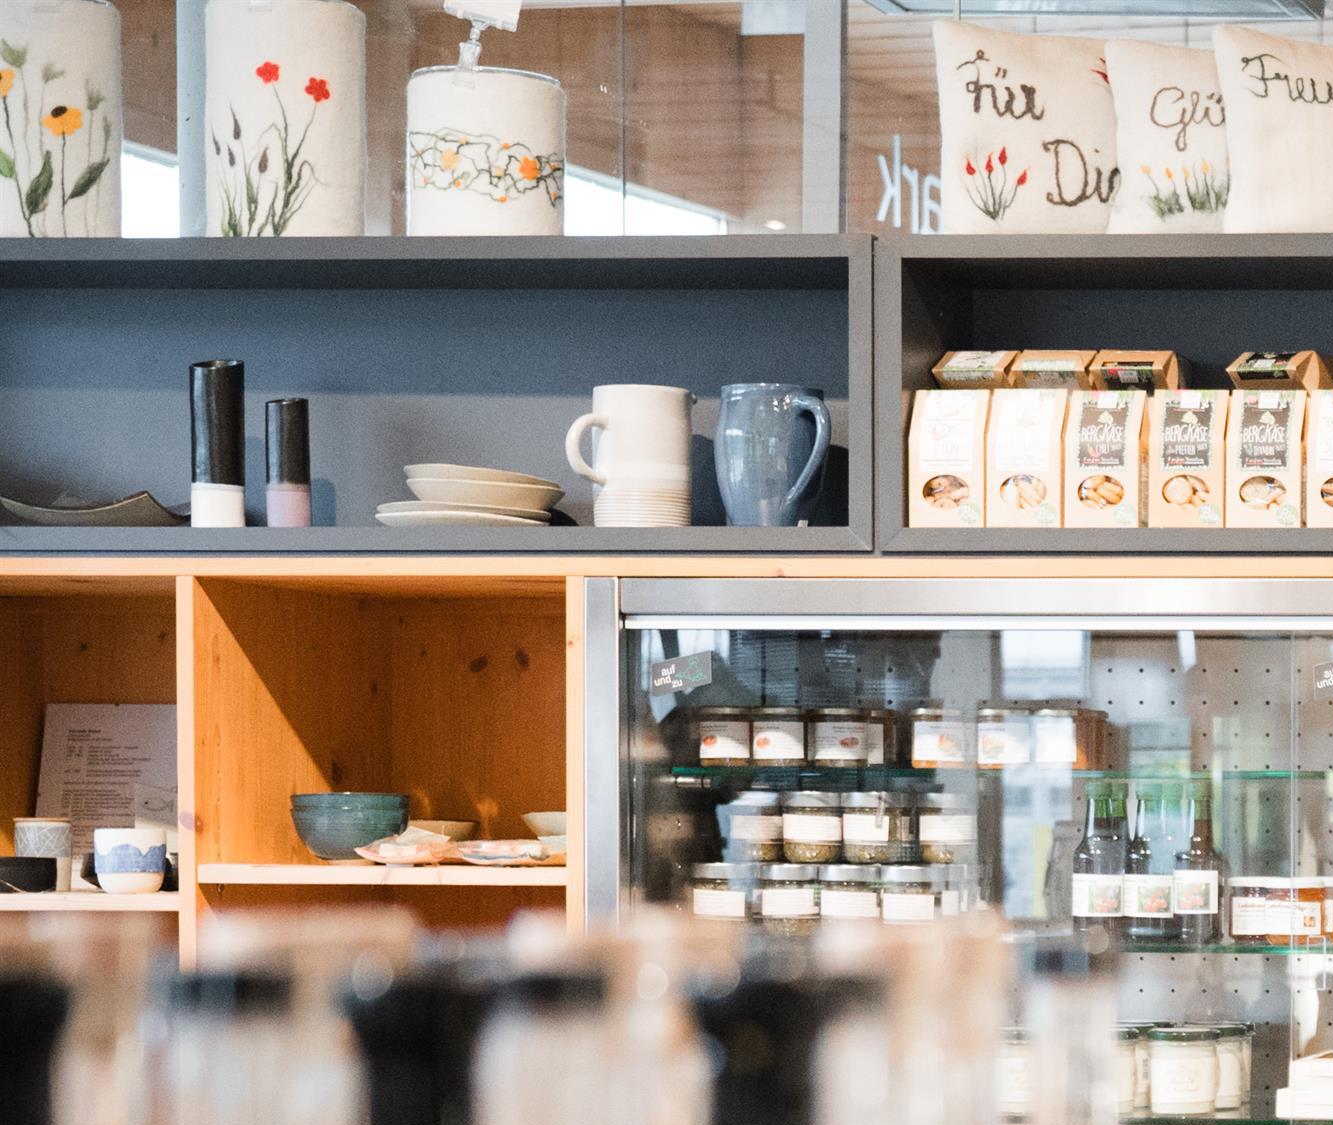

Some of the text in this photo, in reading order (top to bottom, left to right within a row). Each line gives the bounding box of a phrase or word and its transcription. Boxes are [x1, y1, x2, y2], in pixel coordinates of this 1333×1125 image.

[957, 50, 1045, 121] Für
[661, 663, 676, 676] auf
[654, 675, 672, 687] und
[672, 680, 683, 688] zu
